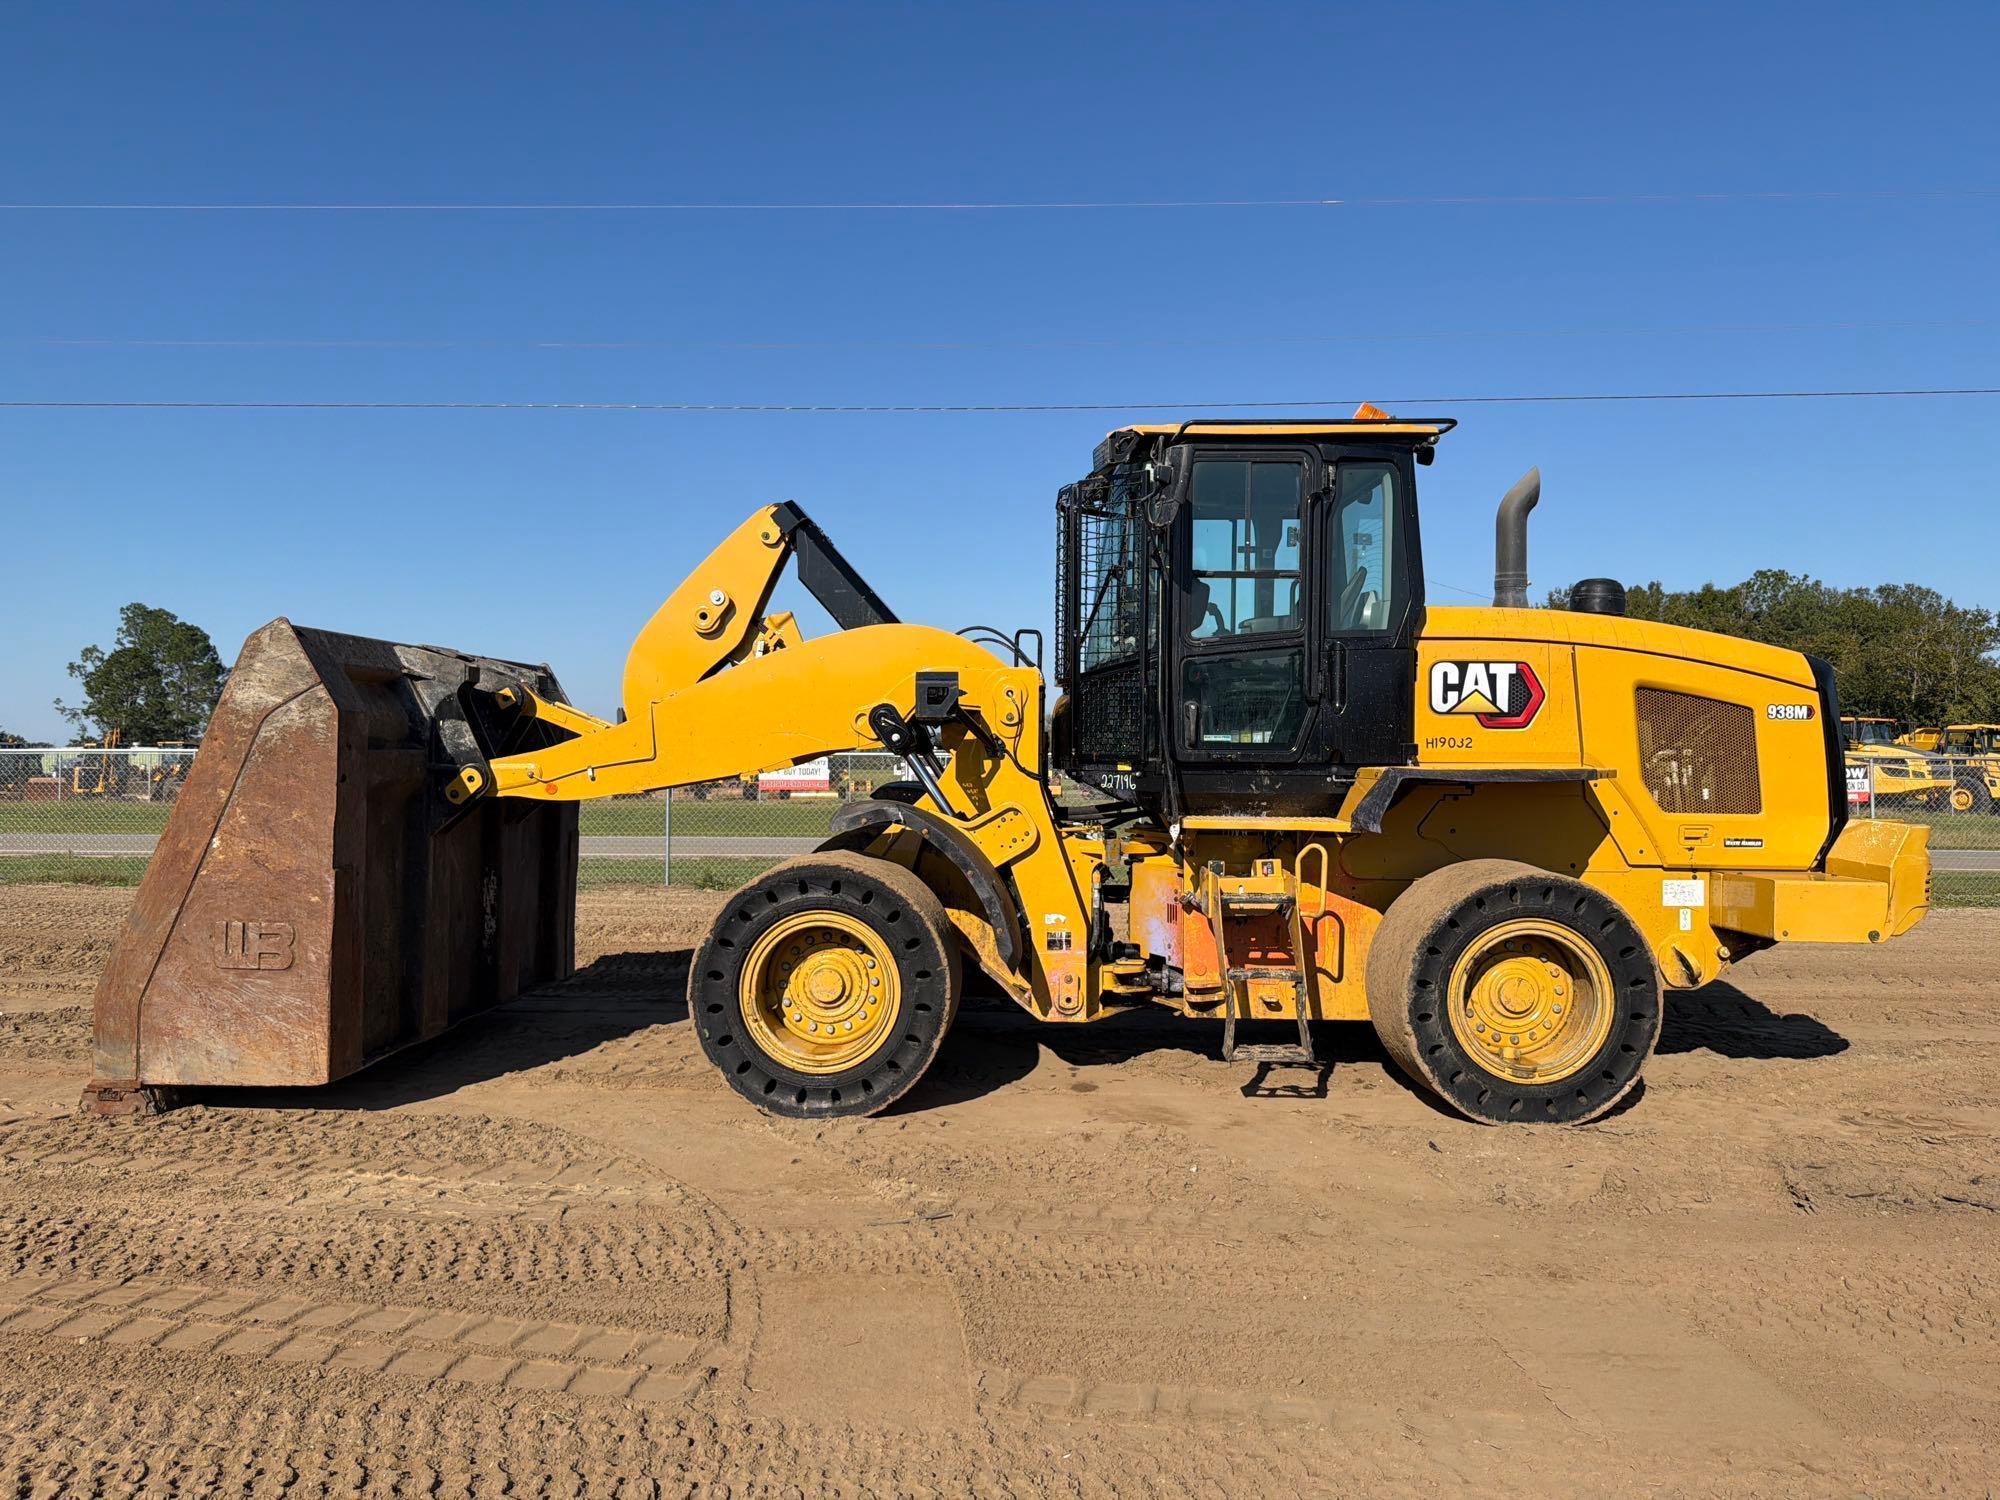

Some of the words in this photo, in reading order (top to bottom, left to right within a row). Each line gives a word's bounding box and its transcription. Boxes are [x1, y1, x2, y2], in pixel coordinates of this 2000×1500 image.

[1431, 661, 1517, 713] CAT
[1767, 704, 1808, 719] 938M
[799, 767, 821, 777] TODAY!
[1100, 774, 1137, 790] 227196
